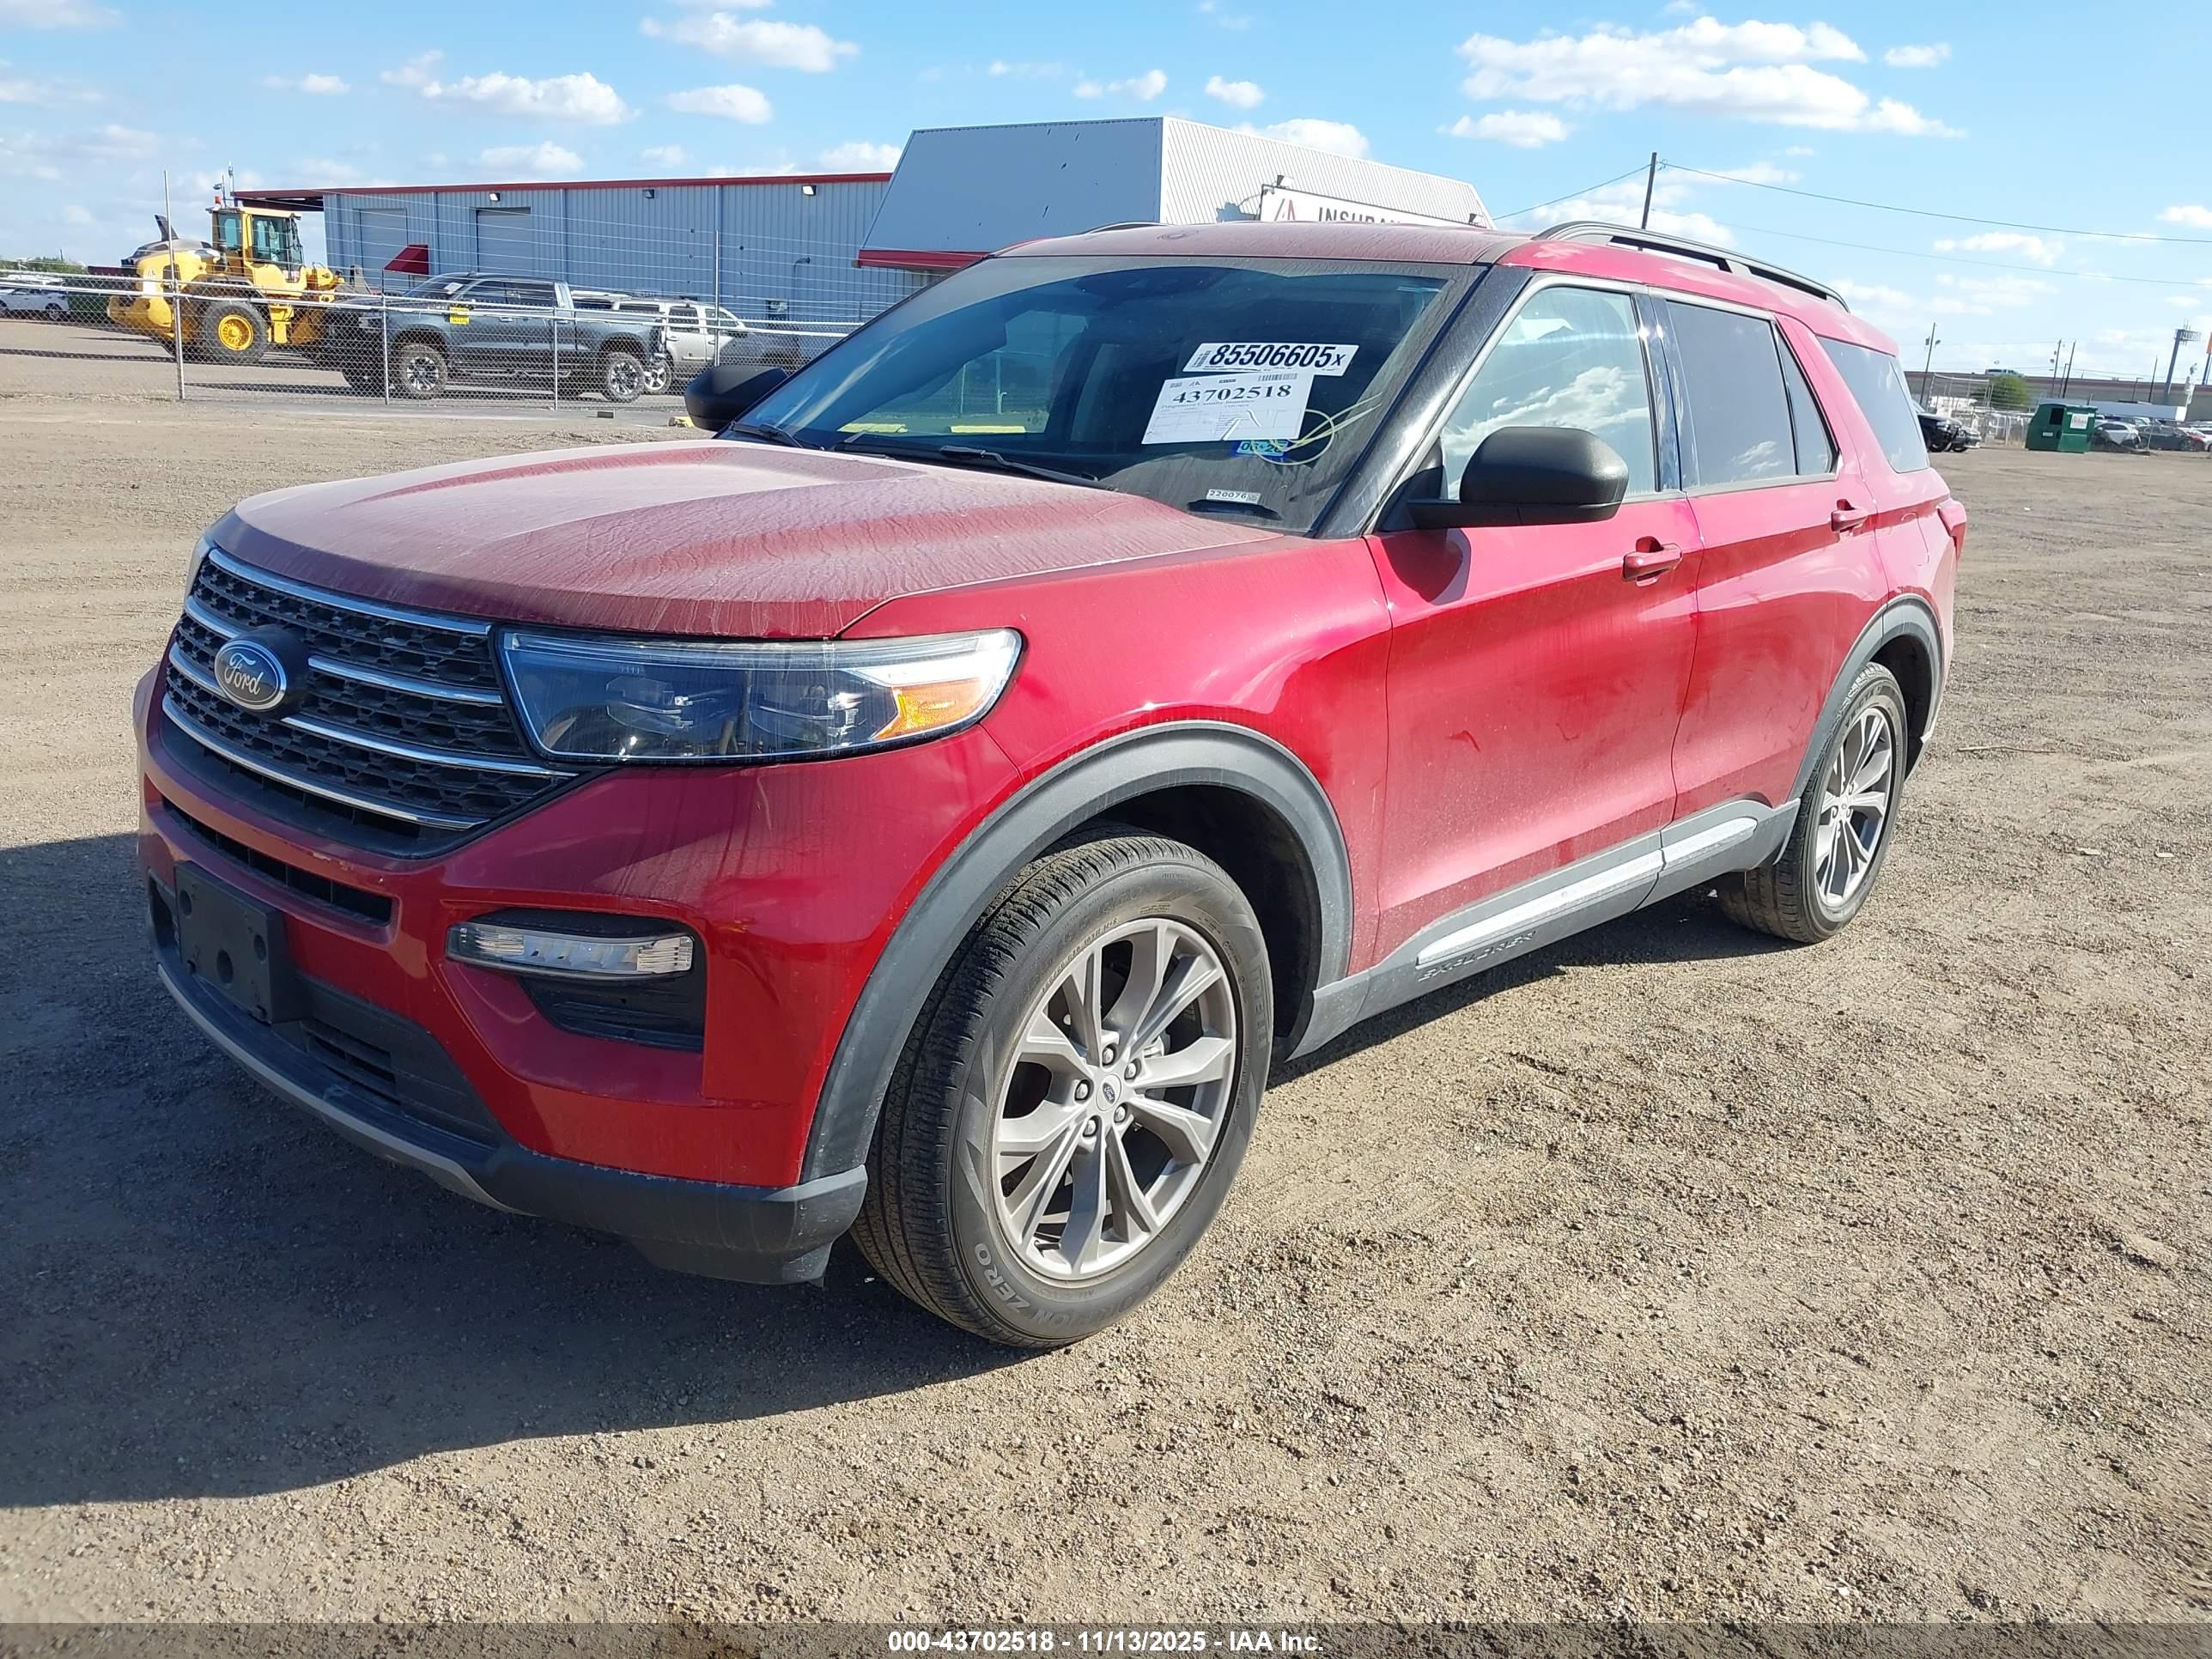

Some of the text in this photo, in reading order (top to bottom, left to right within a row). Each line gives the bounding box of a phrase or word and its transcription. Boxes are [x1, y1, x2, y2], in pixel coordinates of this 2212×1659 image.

[1172, 384, 1292, 404] 43702518
[224, 653, 264, 695] Ford
[975, 1243, 1031, 1313] ZERO
